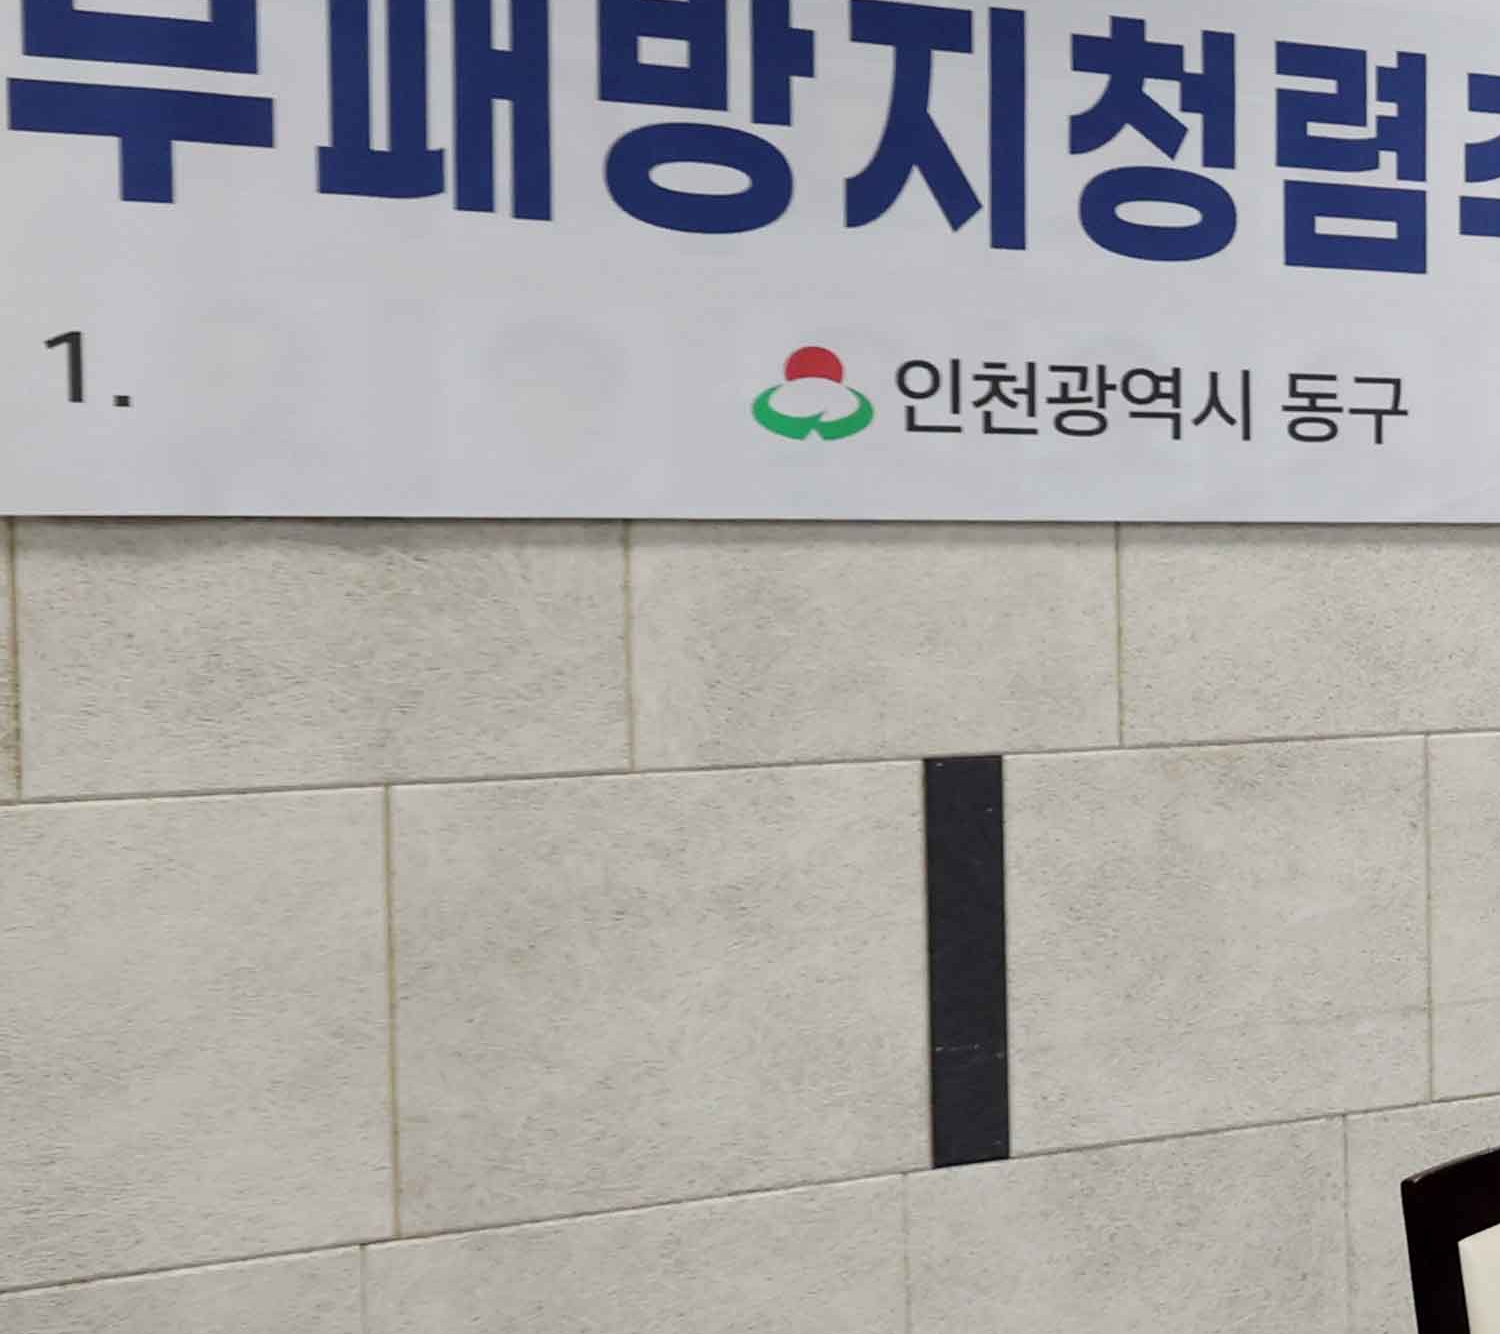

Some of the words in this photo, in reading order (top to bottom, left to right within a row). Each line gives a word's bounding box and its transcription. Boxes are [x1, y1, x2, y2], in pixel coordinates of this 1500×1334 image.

[44, 330, 131, 408] 1.
[895, 357, 1252, 442] 인천광역시
[1281, 372, 1409, 446] 동구
